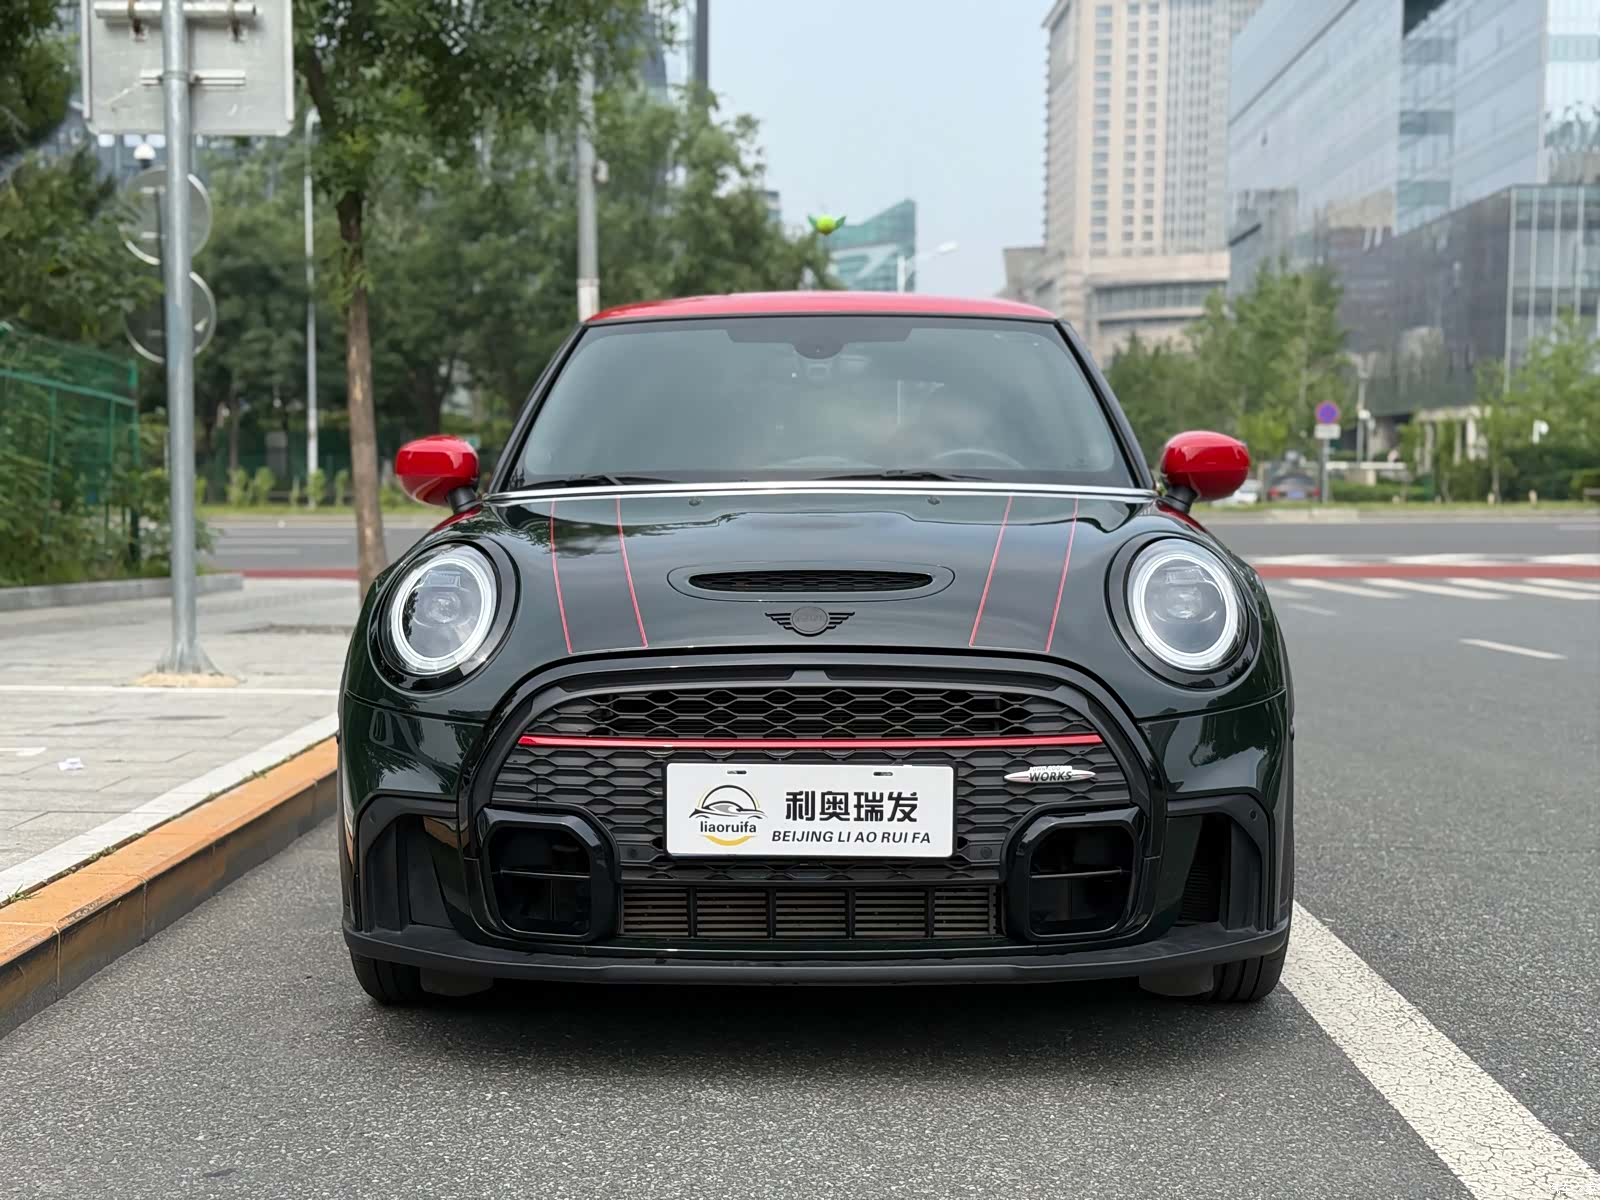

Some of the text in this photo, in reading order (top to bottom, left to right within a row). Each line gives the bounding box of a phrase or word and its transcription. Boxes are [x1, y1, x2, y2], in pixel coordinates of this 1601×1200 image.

[1029, 771, 1072, 781] WORKS
[785, 790, 919, 823] 利奥瑞发
[700, 821, 757, 833] liaoruifa
[771, 830, 834, 843] BEIJING
[880, 832, 908, 844] RUI
[911, 832, 931, 844] FA
